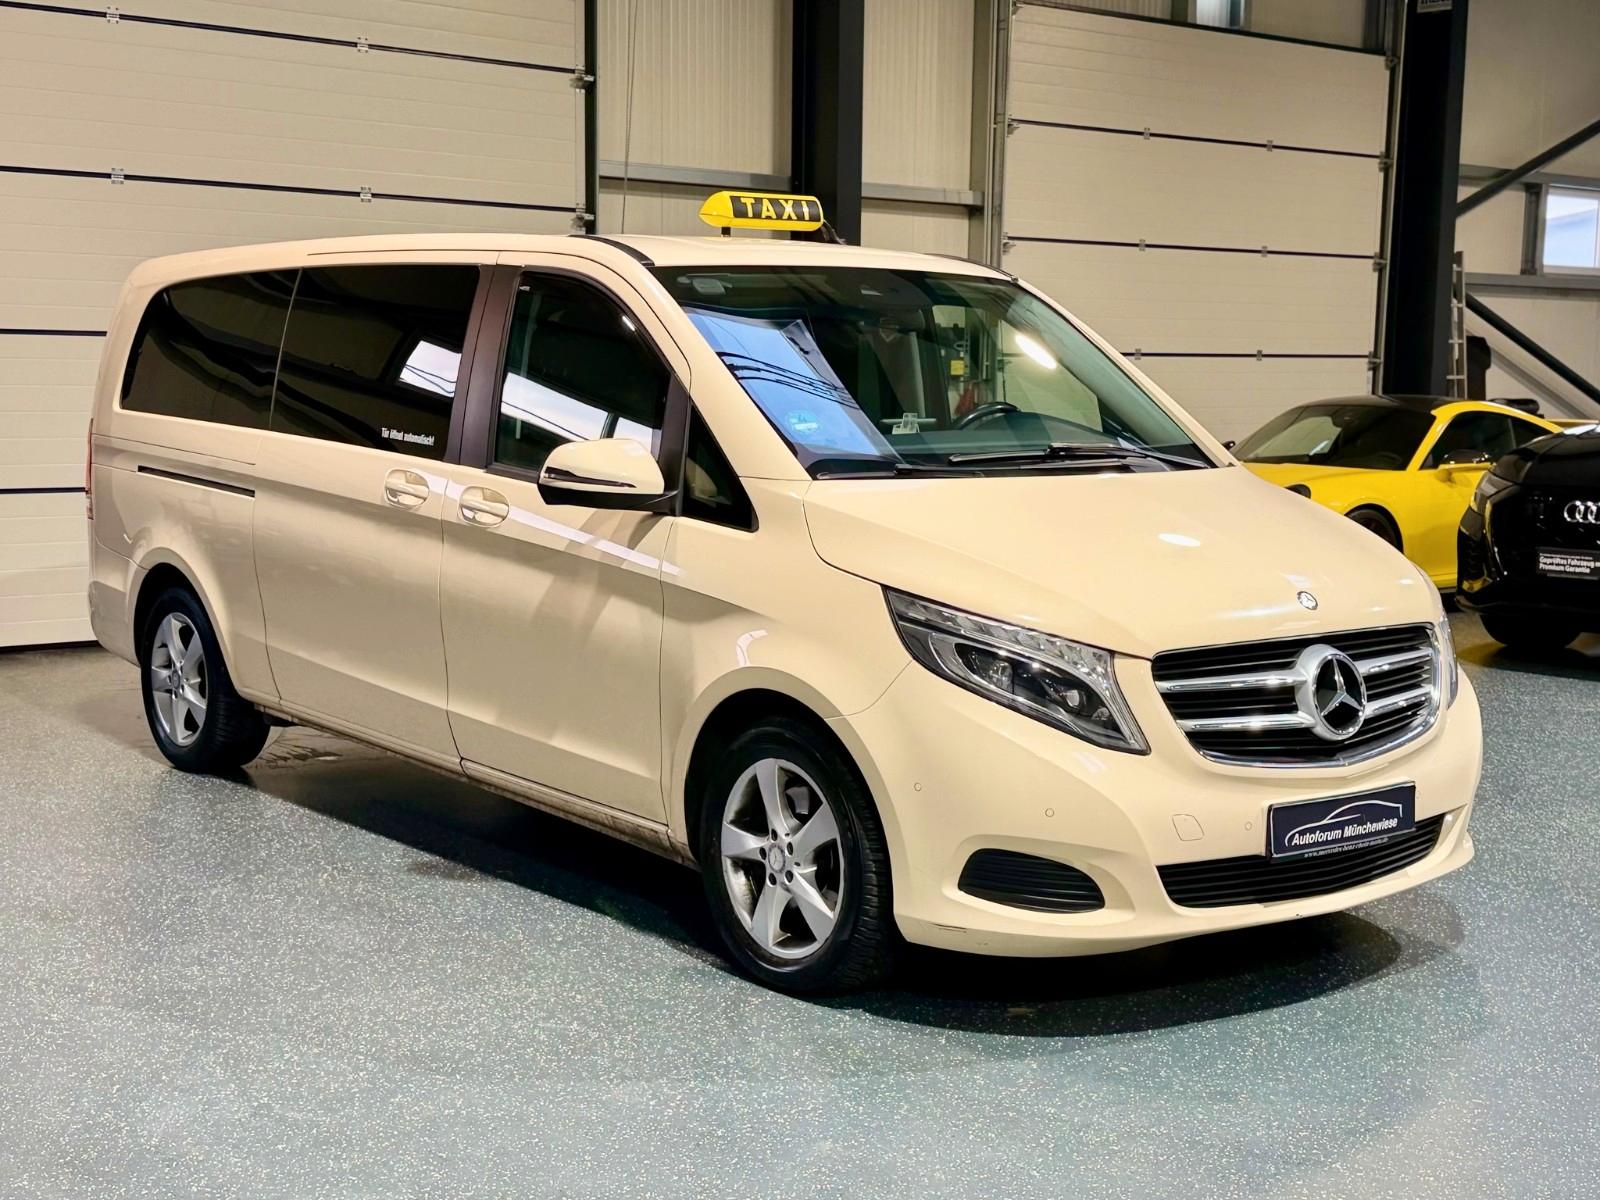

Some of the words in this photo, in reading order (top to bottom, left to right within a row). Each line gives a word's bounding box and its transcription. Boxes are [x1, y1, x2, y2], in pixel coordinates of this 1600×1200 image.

[740, 197, 810, 221] TAXI
[1539, 563, 1565, 571] Premium
[1565, 565, 1590, 573] Garantie
[1567, 558, 1594, 568] Fahrzeug
[1291, 830, 1342, 846] Autoforum
[1343, 818, 1398, 837] Münchewiese
